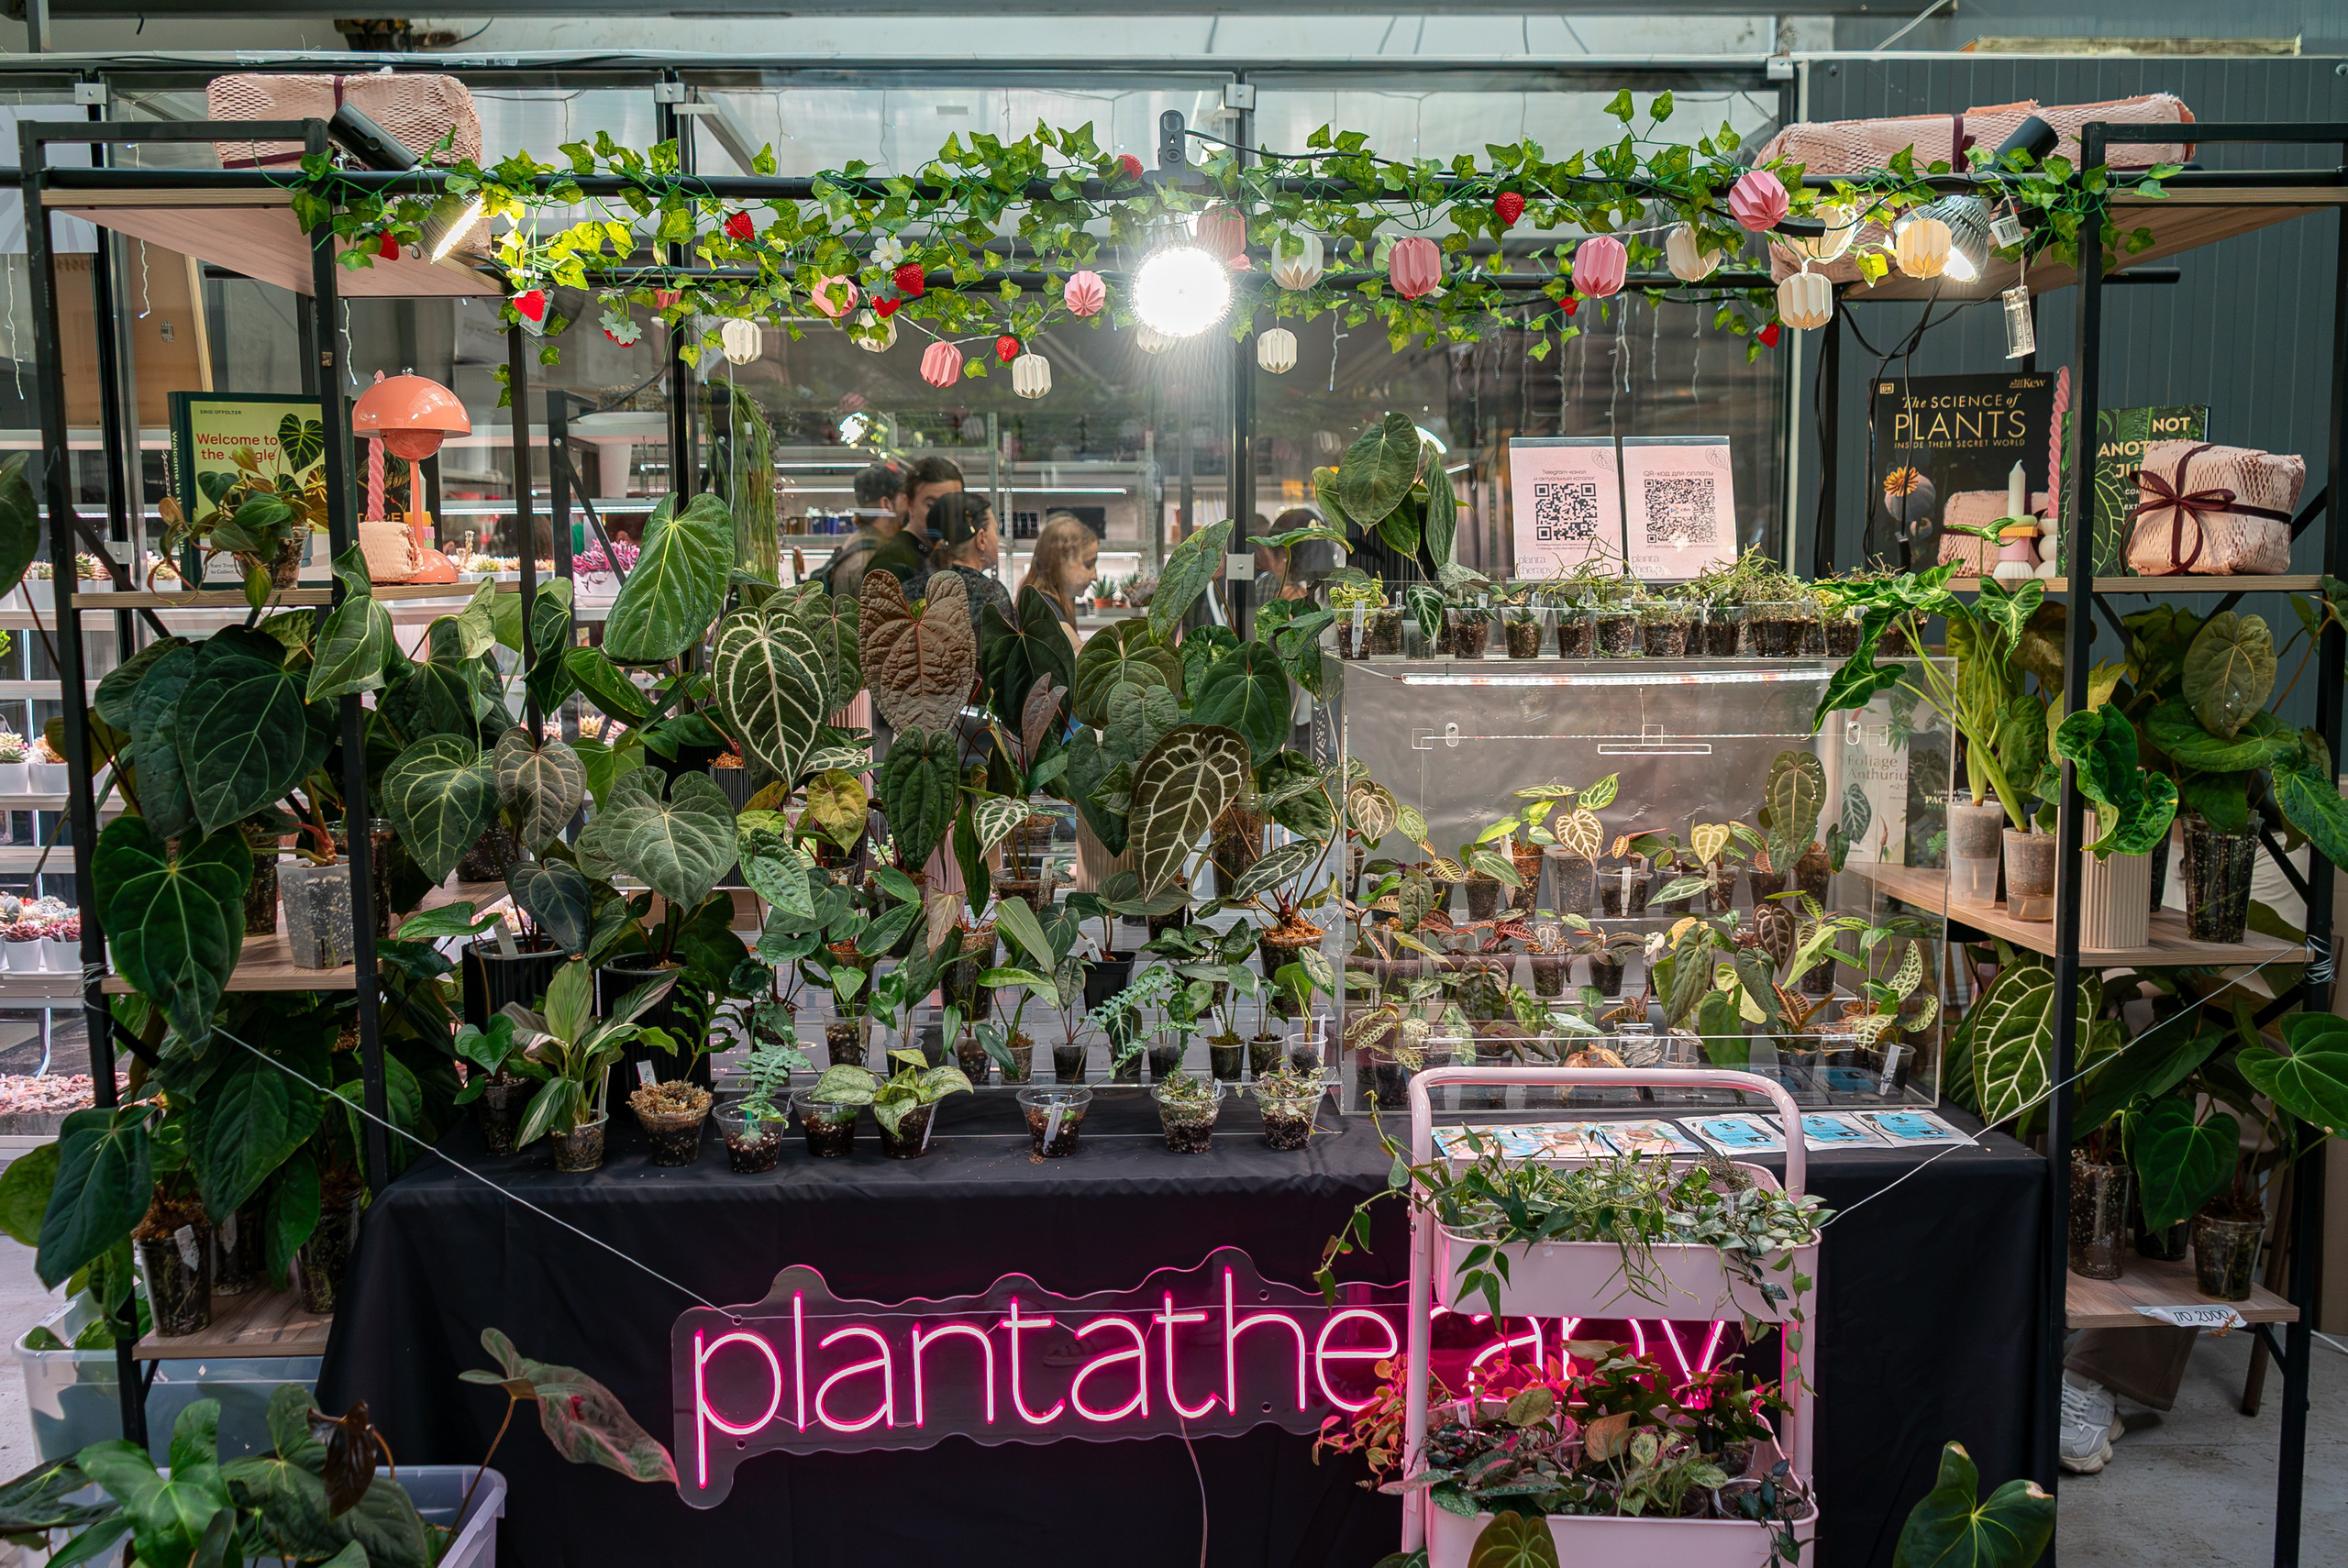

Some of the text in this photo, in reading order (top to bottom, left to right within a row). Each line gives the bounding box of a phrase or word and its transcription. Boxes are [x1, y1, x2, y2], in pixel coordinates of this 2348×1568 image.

[2023, 378, 2046, 388] Kew
[1901, 392, 2021, 409] The SCIENCE of
[1895, 410, 2026, 441] PLANTS
[2152, 416, 2191, 433] NOT
[196, 433, 278, 446] Welcome to
[1894, 441, 1924, 450] INSDE
[1956, 439, 1988, 448] SECRET
[1992, 438, 2025, 447] WORLD
[172, 431, 180, 480] Welcome
[201, 448, 225, 460] the
[1518, 555, 1546, 566] planta
[1632, 554, 1660, 565] planta
[1847, 754, 1898, 770] Foliage
[1846, 767, 1908, 780] Anthuriu
[2195, 1309, 2230, 1322] 2000
